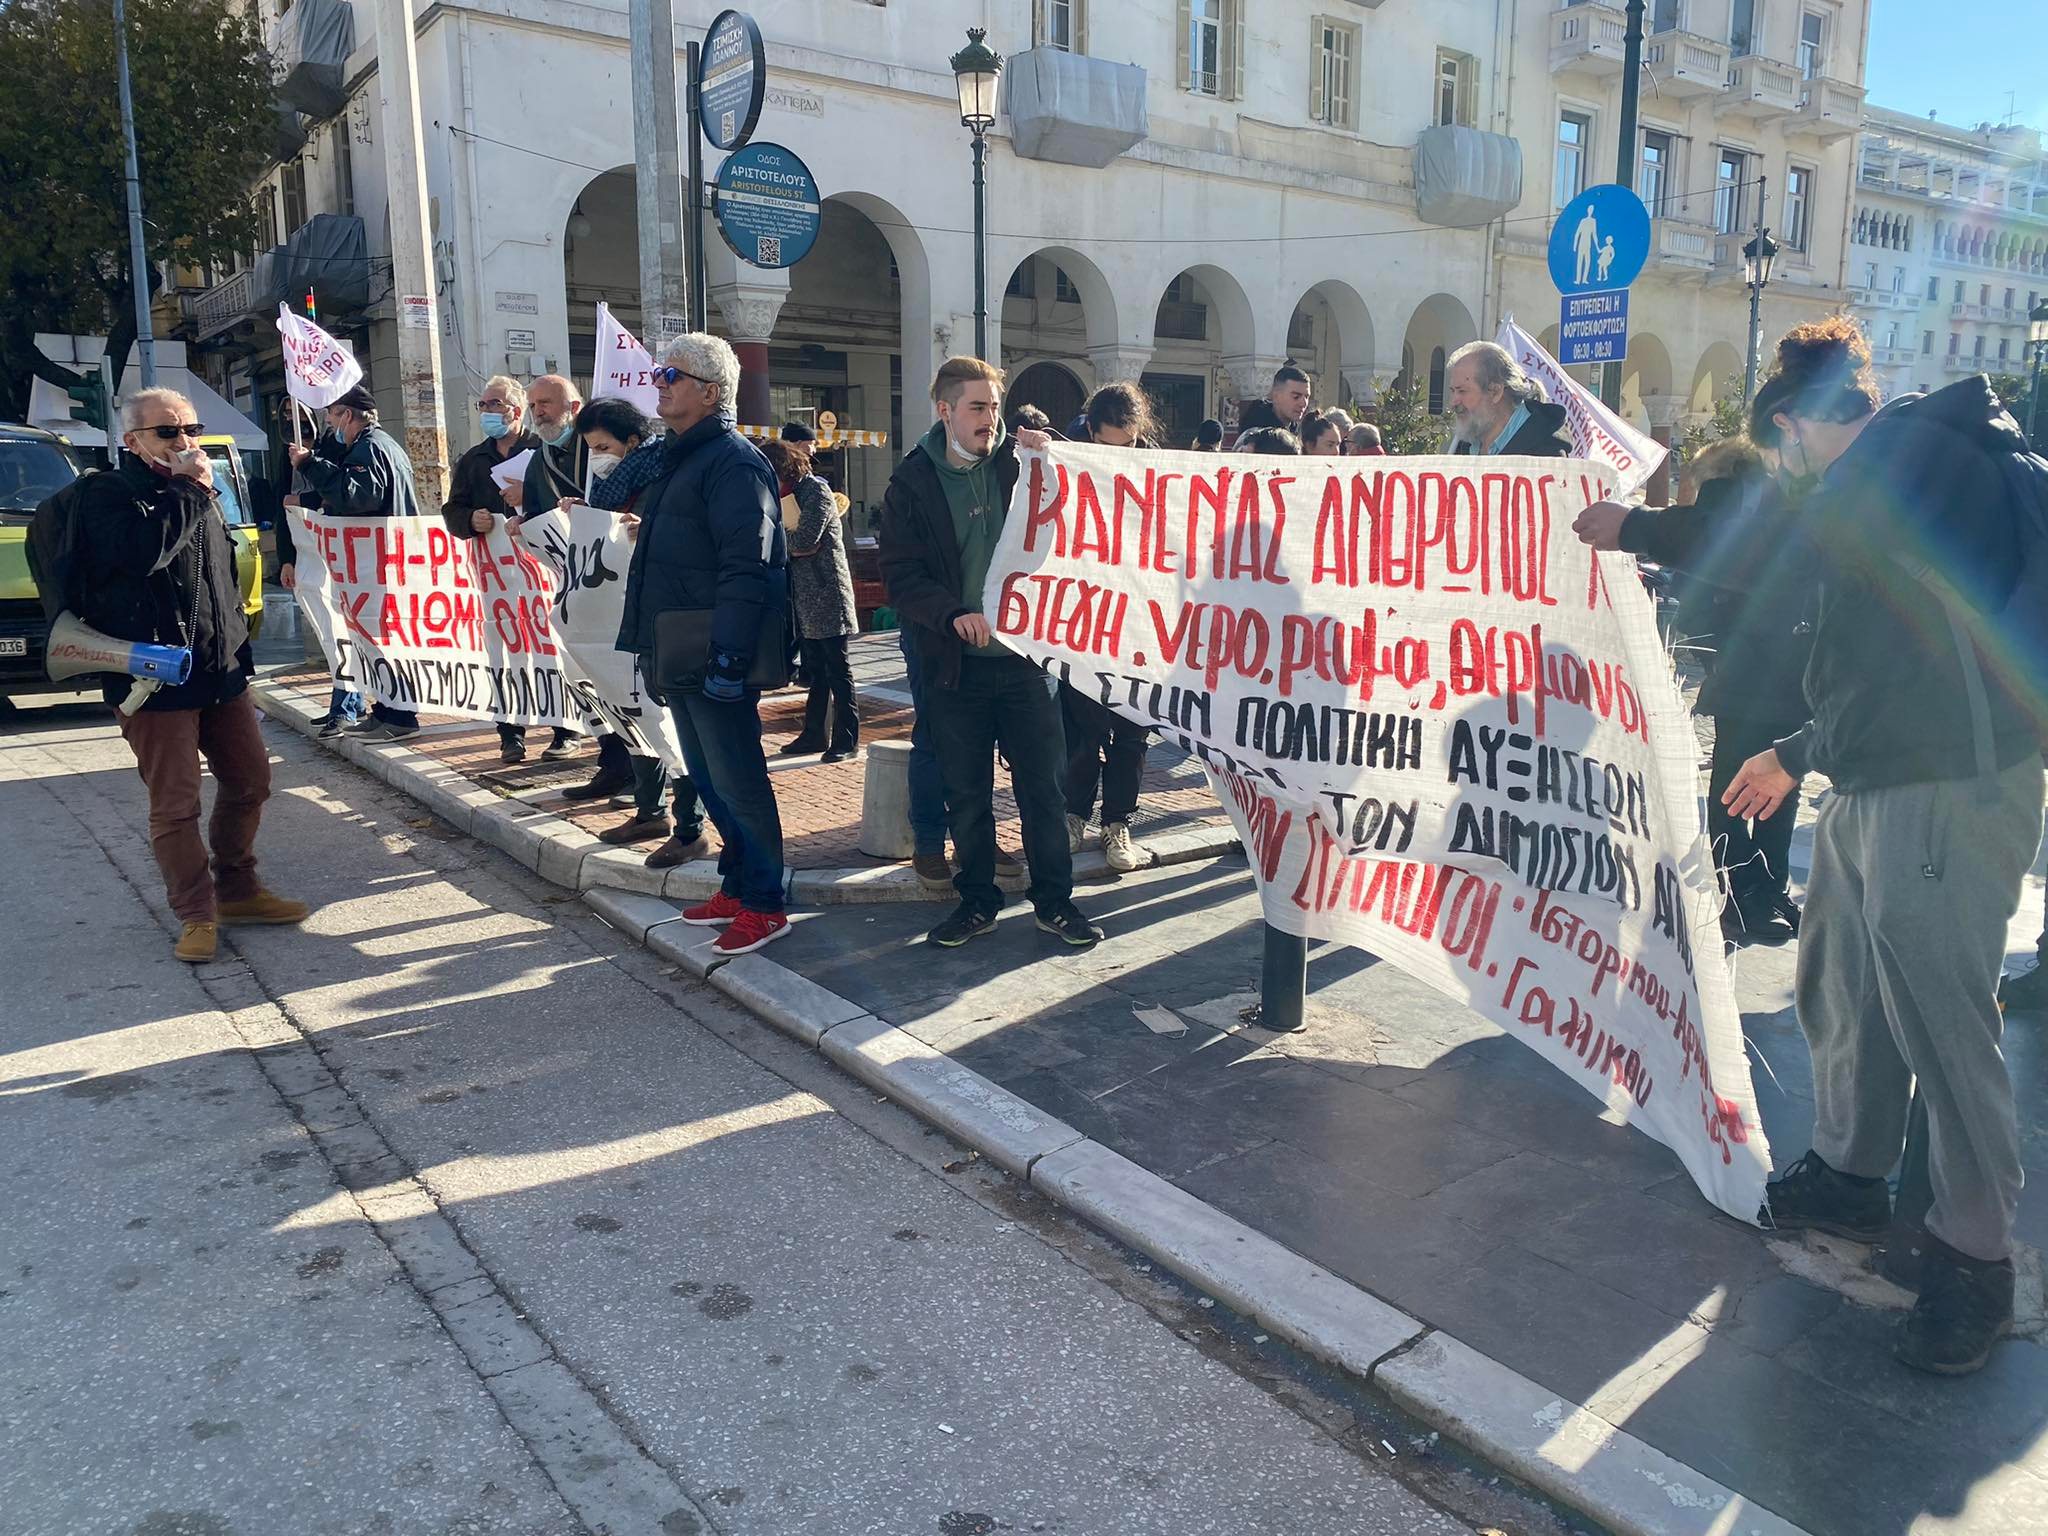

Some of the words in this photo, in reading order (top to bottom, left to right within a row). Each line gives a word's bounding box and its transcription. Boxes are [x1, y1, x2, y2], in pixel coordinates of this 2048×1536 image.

[757, 154, 781, 166] ΟΔΟΣ
[730, 165, 806, 187] ΑΡΙΣΤΟΤΕΛΟΥΣ
[731, 180, 793, 198] ARISTOTELOUS
[1570, 296, 1612, 317] ΕΠΙΤΡΕΠΕΤΑΙ
[1614, 296, 1620, 312] Η
[1564, 316, 1625, 338] ΦΟΡΤΟΕΚΦΟΡΤΩΣΗ
[1024, 457, 1296, 585] ΚΑΝΕΝΑΣ
[1235, 696, 1423, 771] ΠΟΛΙΤΙΚΗ
